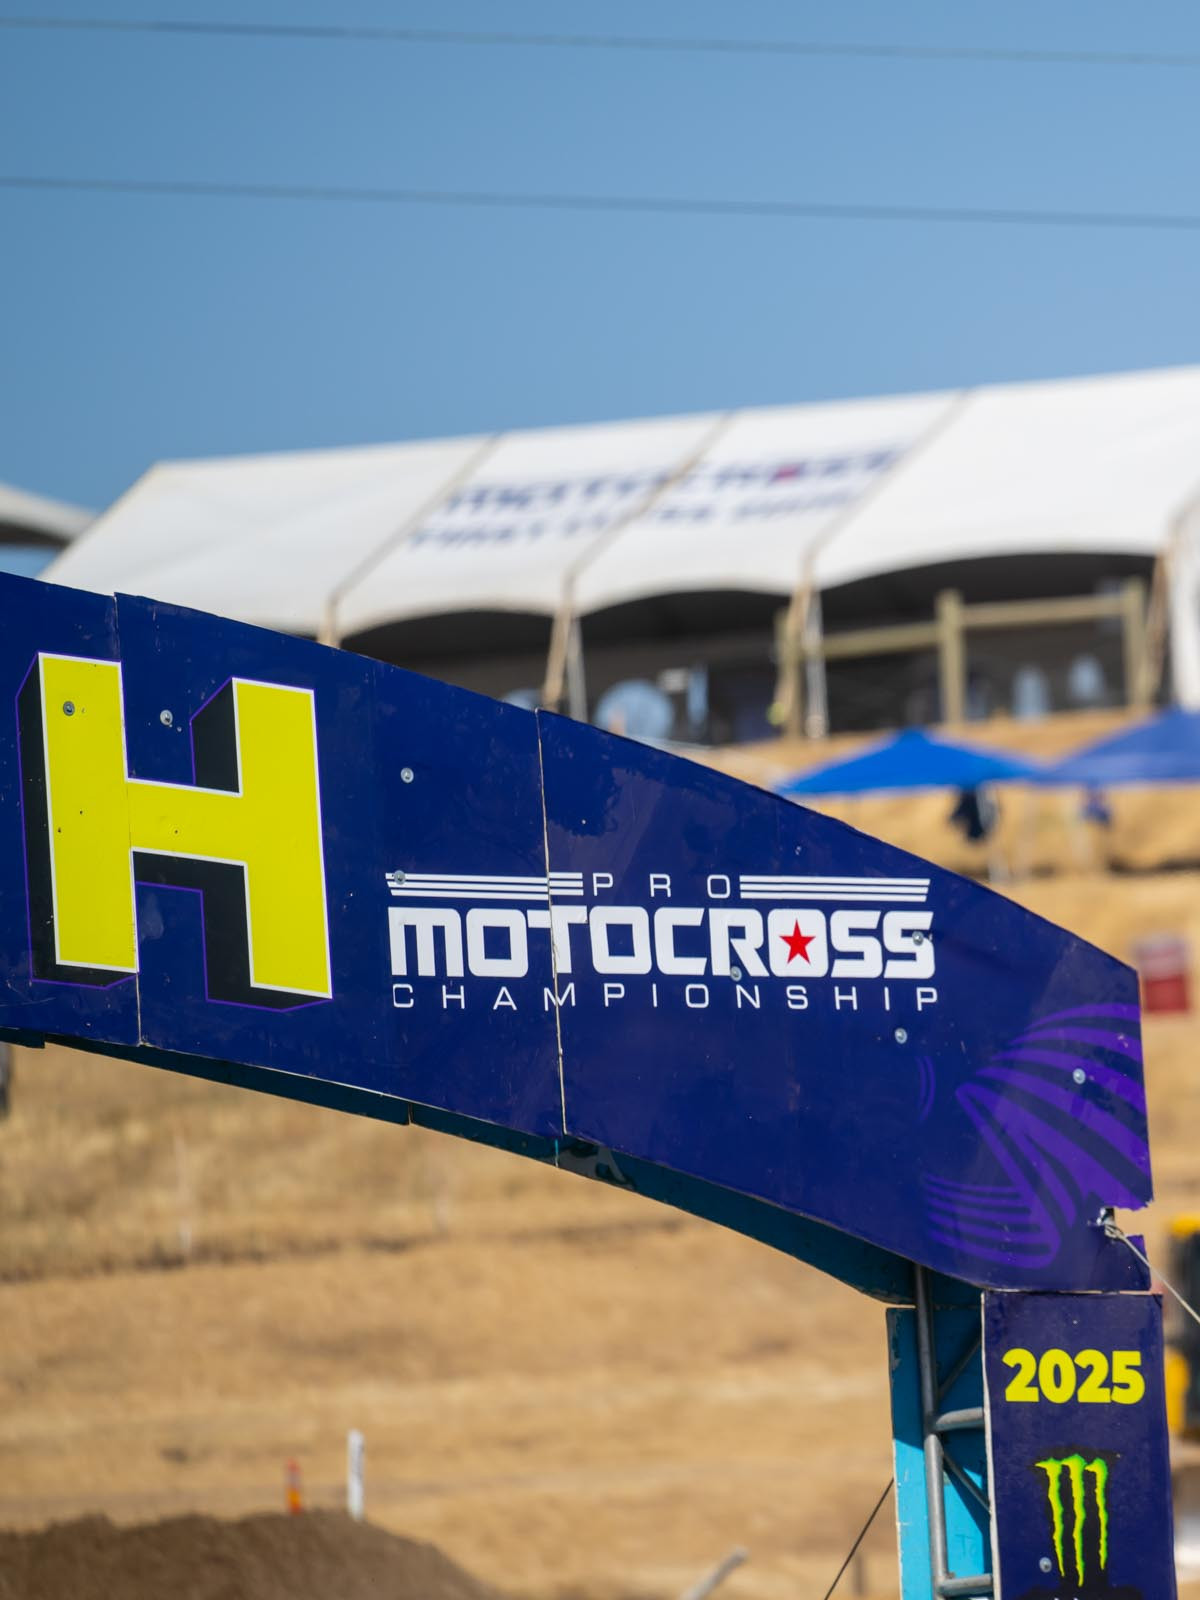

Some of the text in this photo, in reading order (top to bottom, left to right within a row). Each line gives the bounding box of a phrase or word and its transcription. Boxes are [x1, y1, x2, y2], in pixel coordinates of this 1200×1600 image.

[38, 651, 333, 1000] H
[593, 873, 731, 899] PRO
[388, 905, 936, 979] MOTOCROSS
[392, 982, 938, 1011] CHAMPIONSHIP
[1001, 1348, 1146, 1405] 2025
